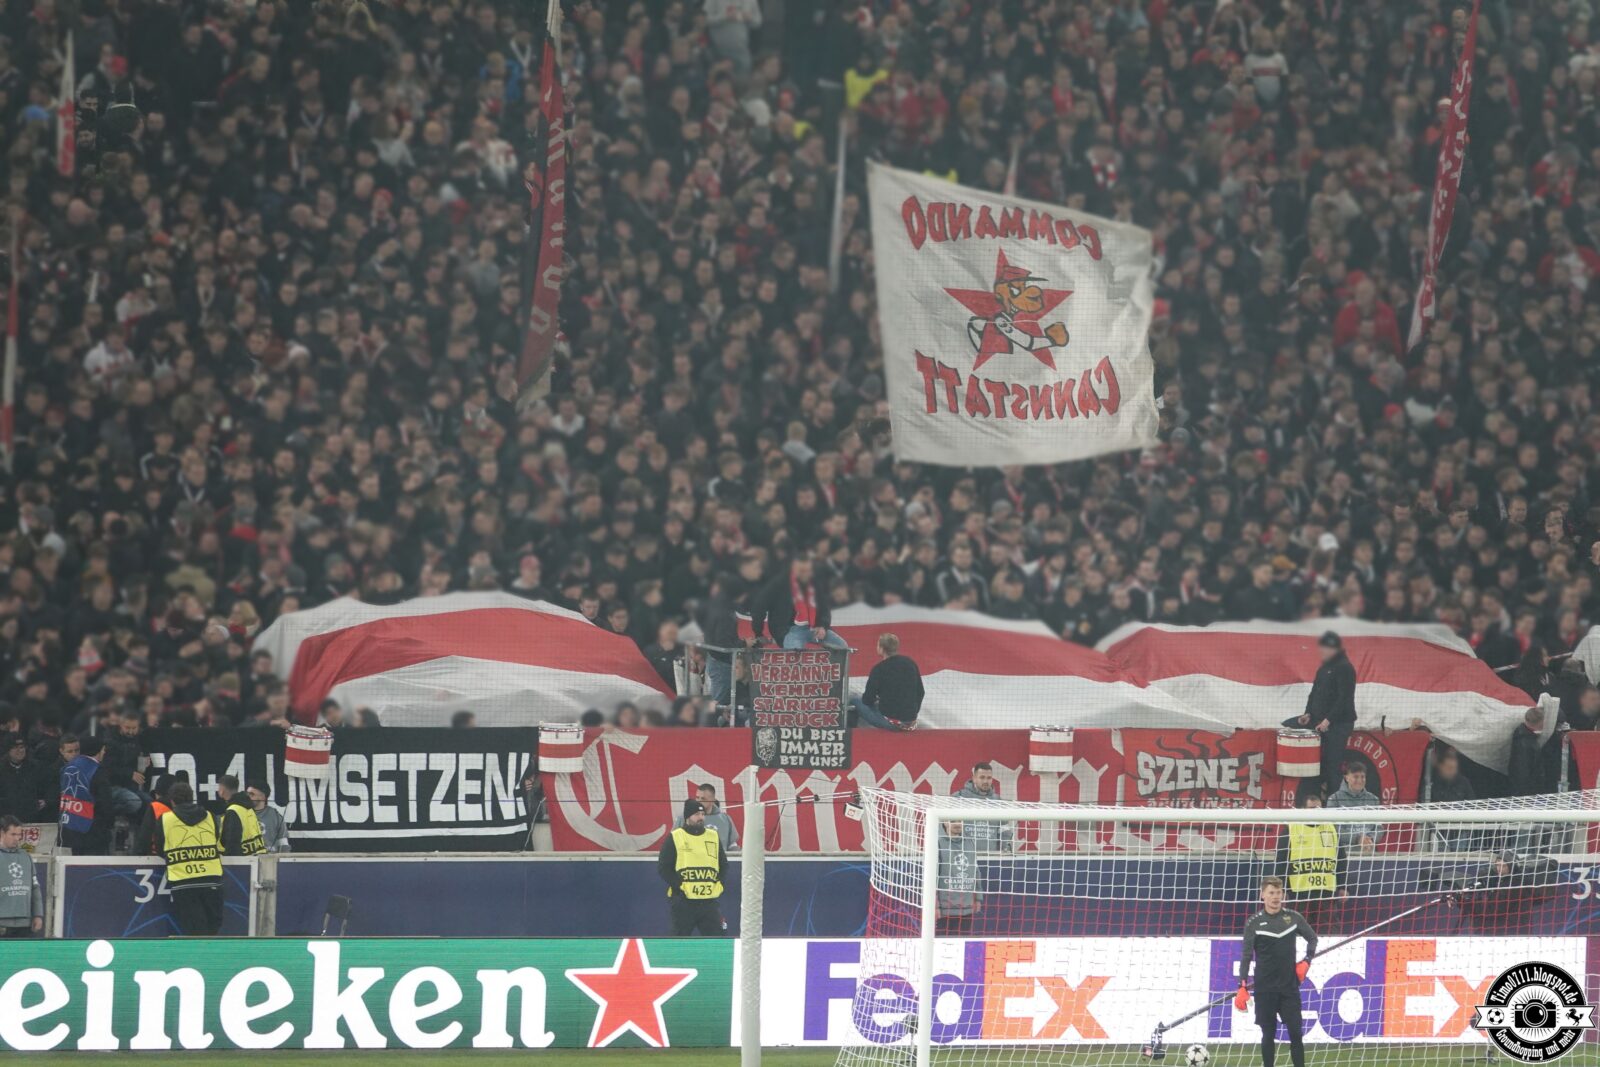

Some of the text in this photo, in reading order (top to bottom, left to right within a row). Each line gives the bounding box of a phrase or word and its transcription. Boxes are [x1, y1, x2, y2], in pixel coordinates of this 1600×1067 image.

[760, 651, 831, 666] JEDER
[751, 663, 841, 682] VERBANNTE
[760, 682, 833, 697] KEHRT
[780, 728, 846, 741] DU BIST
[780, 741, 845, 755] IMMER
[780, 755, 847, 767] BEI UNS!
[1137, 751, 1240, 796] SZENE
[266, 752, 530, 825] UMSETZEN!
[1382, 787, 1397, 804] 97
[167, 847, 217, 863] STEWARD
[185, 864, 206, 874] 015
[692, 885, 712, 896] 423
[1572, 867, 1600, 900] 3
[803, 941, 1109, 1043] FedEx
